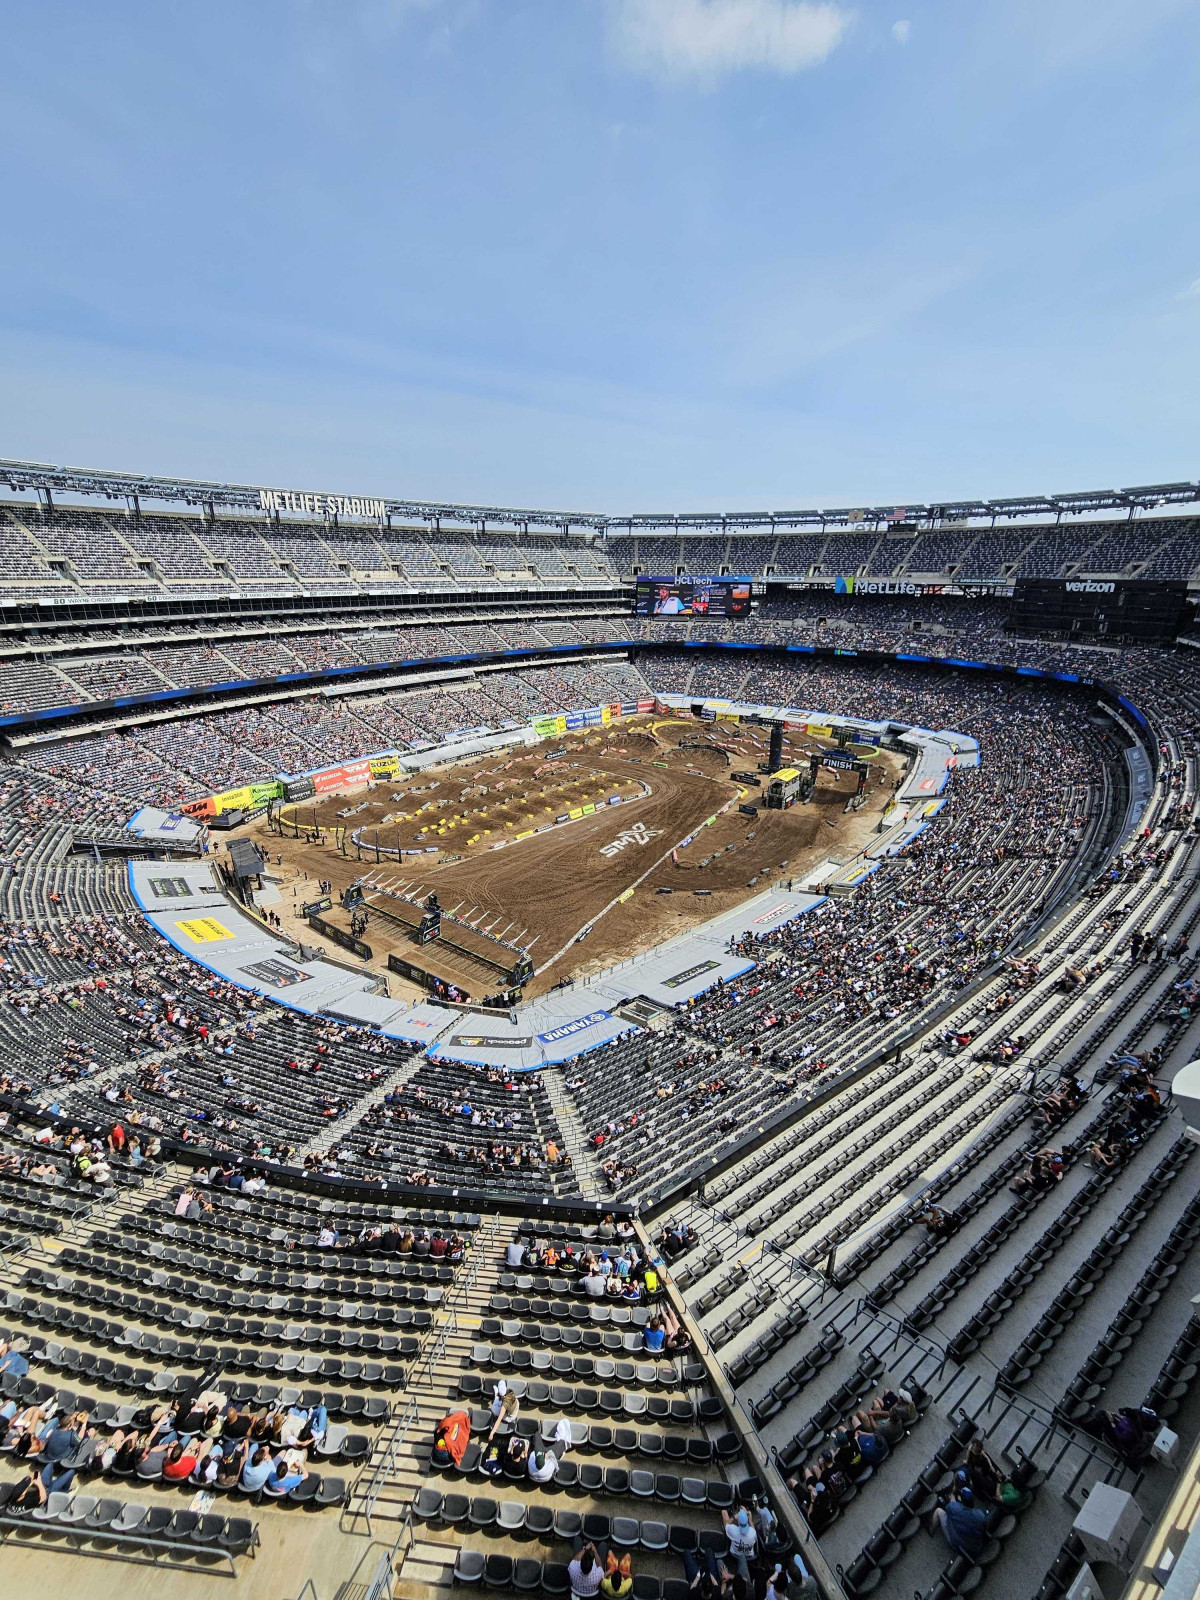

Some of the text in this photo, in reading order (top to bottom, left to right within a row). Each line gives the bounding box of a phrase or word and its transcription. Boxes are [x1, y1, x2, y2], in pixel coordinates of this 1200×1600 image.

[259, 490, 387, 518] METLIFE STADIUM
[674, 577, 713, 585] HCLTech
[1065, 580, 1116, 593] verizon
[855, 580, 916, 594] MetLife
[370, 759, 398, 768] SUZUKI
[822, 759, 853, 770] FINISH
[321, 772, 342, 780] HONDA
[252, 784, 282, 794] Kawasak
[184, 802, 208, 814] KTM
[543, 1017, 595, 1041] YAMAHA
[487, 1038, 527, 1046] peacock
